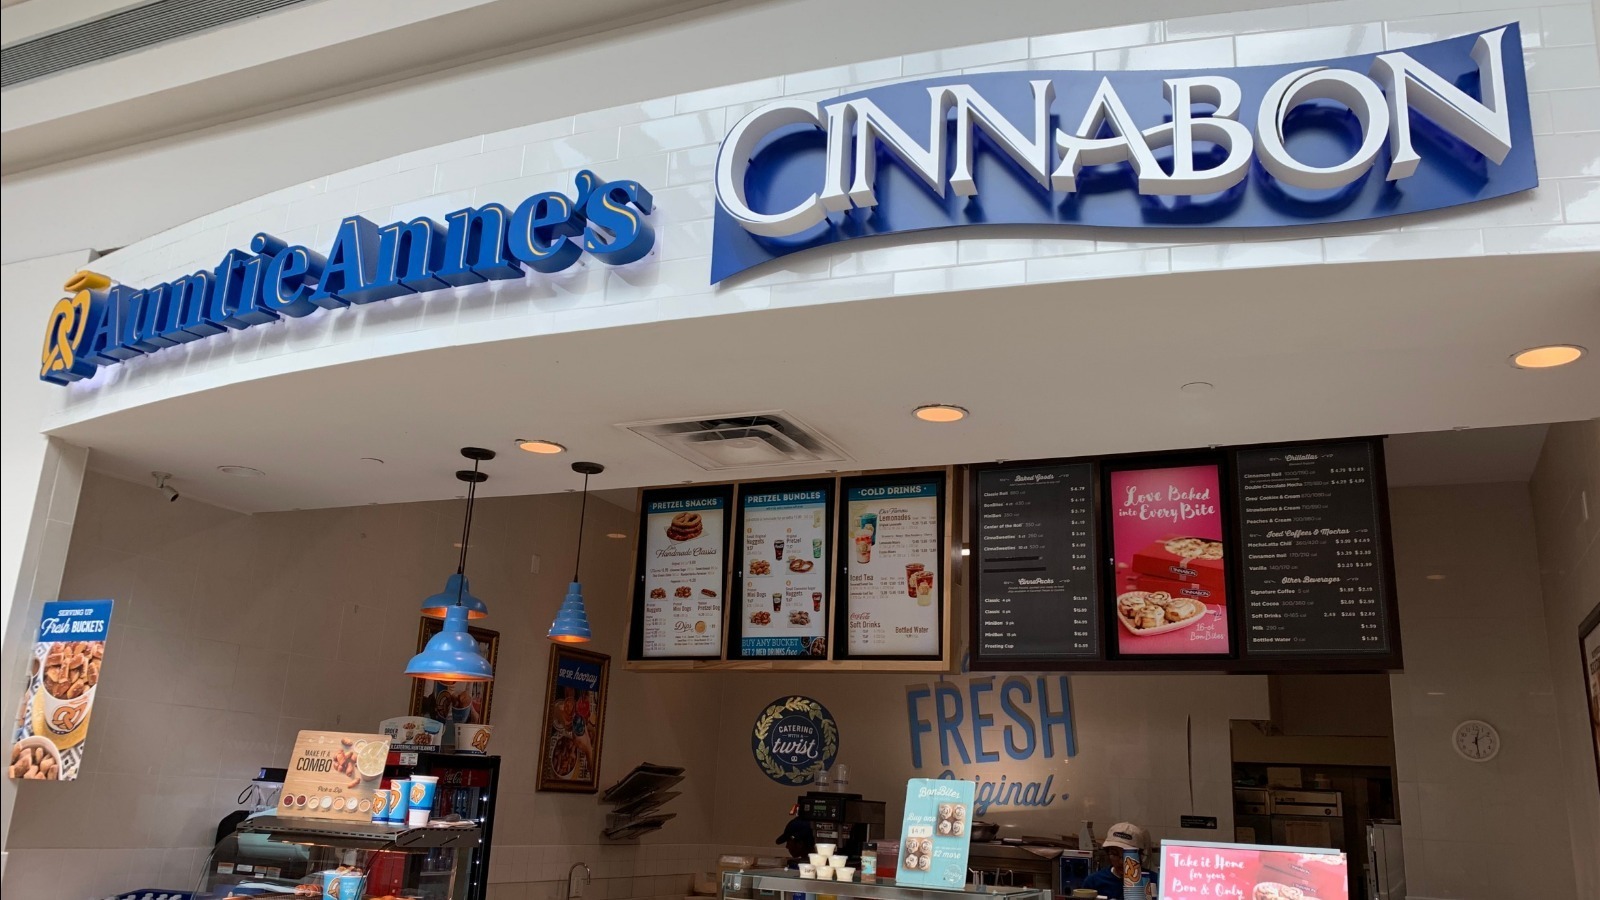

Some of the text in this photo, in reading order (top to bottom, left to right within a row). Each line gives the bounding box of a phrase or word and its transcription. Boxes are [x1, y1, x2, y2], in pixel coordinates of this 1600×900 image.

[714, 25, 1512, 239] CINNABON
[88, 169, 657, 365] Auntie Anne's
[1015, 473, 1054, 482] Baked Goods
[861, 485, 922, 496] COLD DRINKS
[1124, 485, 1210, 507] Love Baked
[747, 491, 821, 503] PRETZEL BUNDLES
[652, 498, 718, 510] PRETZEL SNACKS
[1119, 501, 1215, 523] into Every Bite
[879, 514, 912, 522] Lemonades
[1284, 529, 1312, 538] Coffees
[1320, 528, 1350, 536] Mochas
[746, 538, 765, 546] Nuggets
[786, 537, 802, 545] Pretzel
[655, 548, 717, 560] Handmade Classics
[863, 573, 874, 581] Tea
[1281, 575, 1340, 584] Other Beverages
[756, 591, 767, 599] Dogs
[786, 590, 803, 598] Nuggets
[57, 608, 94, 617] SERVING UP
[646, 606, 662, 614] Nuggets
[682, 605, 692, 613] Dogs
[712, 604, 721, 612] Dog
[41, 617, 104, 637] Fresh BUCKETS
[674, 620, 692, 632] Dips
[850, 620, 881, 629] Soft Drinks
[895, 626, 929, 634] Bottled Water
[742, 638, 799, 647] BUY ANY BUCKET
[742, 648, 752, 656] GET
[756, 648, 767, 656] MED
[768, 647, 785, 656] DRINKS
[785, 646, 798, 656] free
[573, 665, 598, 689] hooray
[907, 675, 1079, 769] FRESH
[778, 724, 813, 734] CATERING
[772, 738, 818, 759] twist
[296, 757, 332, 773] COMBO
[918, 785, 961, 799] BonBites
[938, 770, 1055, 816] iginal
[907, 812, 921, 823] Buy
[1170, 853, 1245, 870] Take it Home
[1189, 869, 1226, 881] for your
[1172, 877, 1246, 900] Bon & Only
